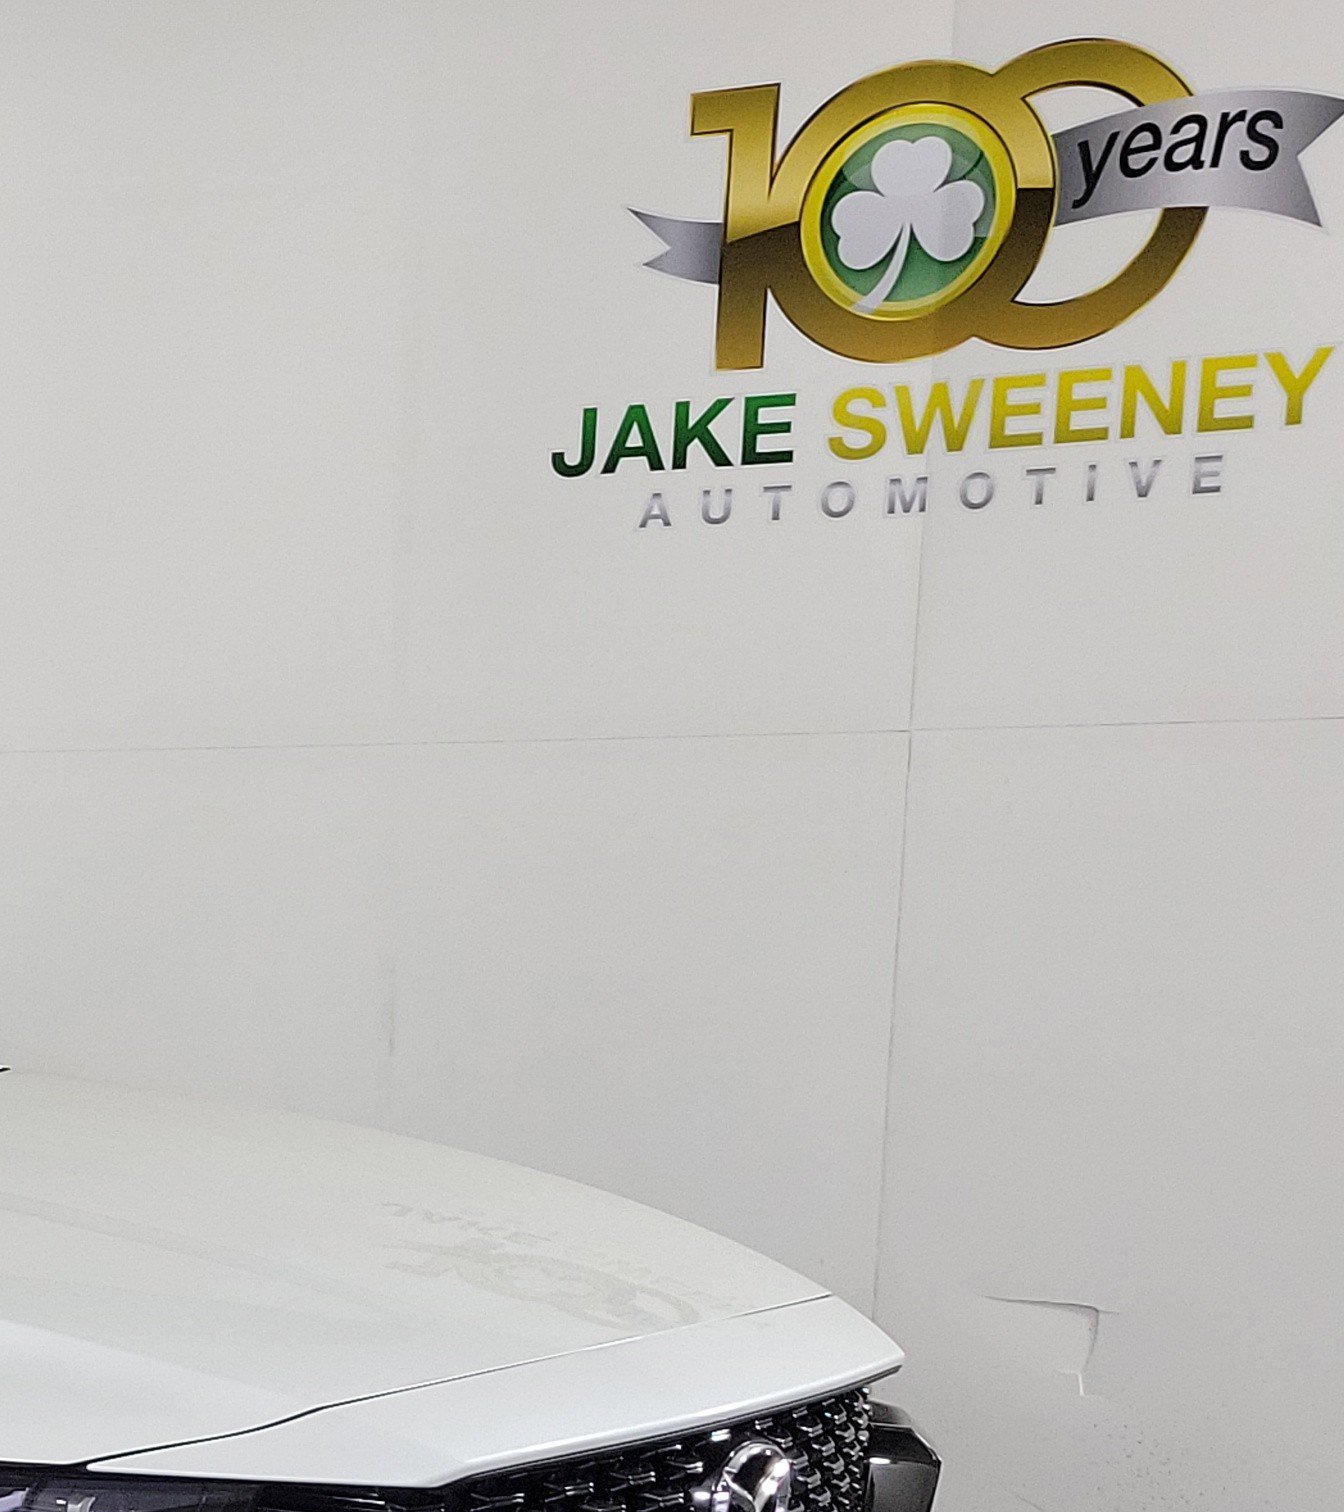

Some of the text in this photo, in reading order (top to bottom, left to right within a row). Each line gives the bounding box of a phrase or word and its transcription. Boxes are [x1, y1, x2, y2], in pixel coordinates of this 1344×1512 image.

[690, 37, 1285, 372] 100 years
[551, 346, 1334, 478] JAKE SWEENEY
[639, 454, 1227, 529] AUTOMOTIVE
